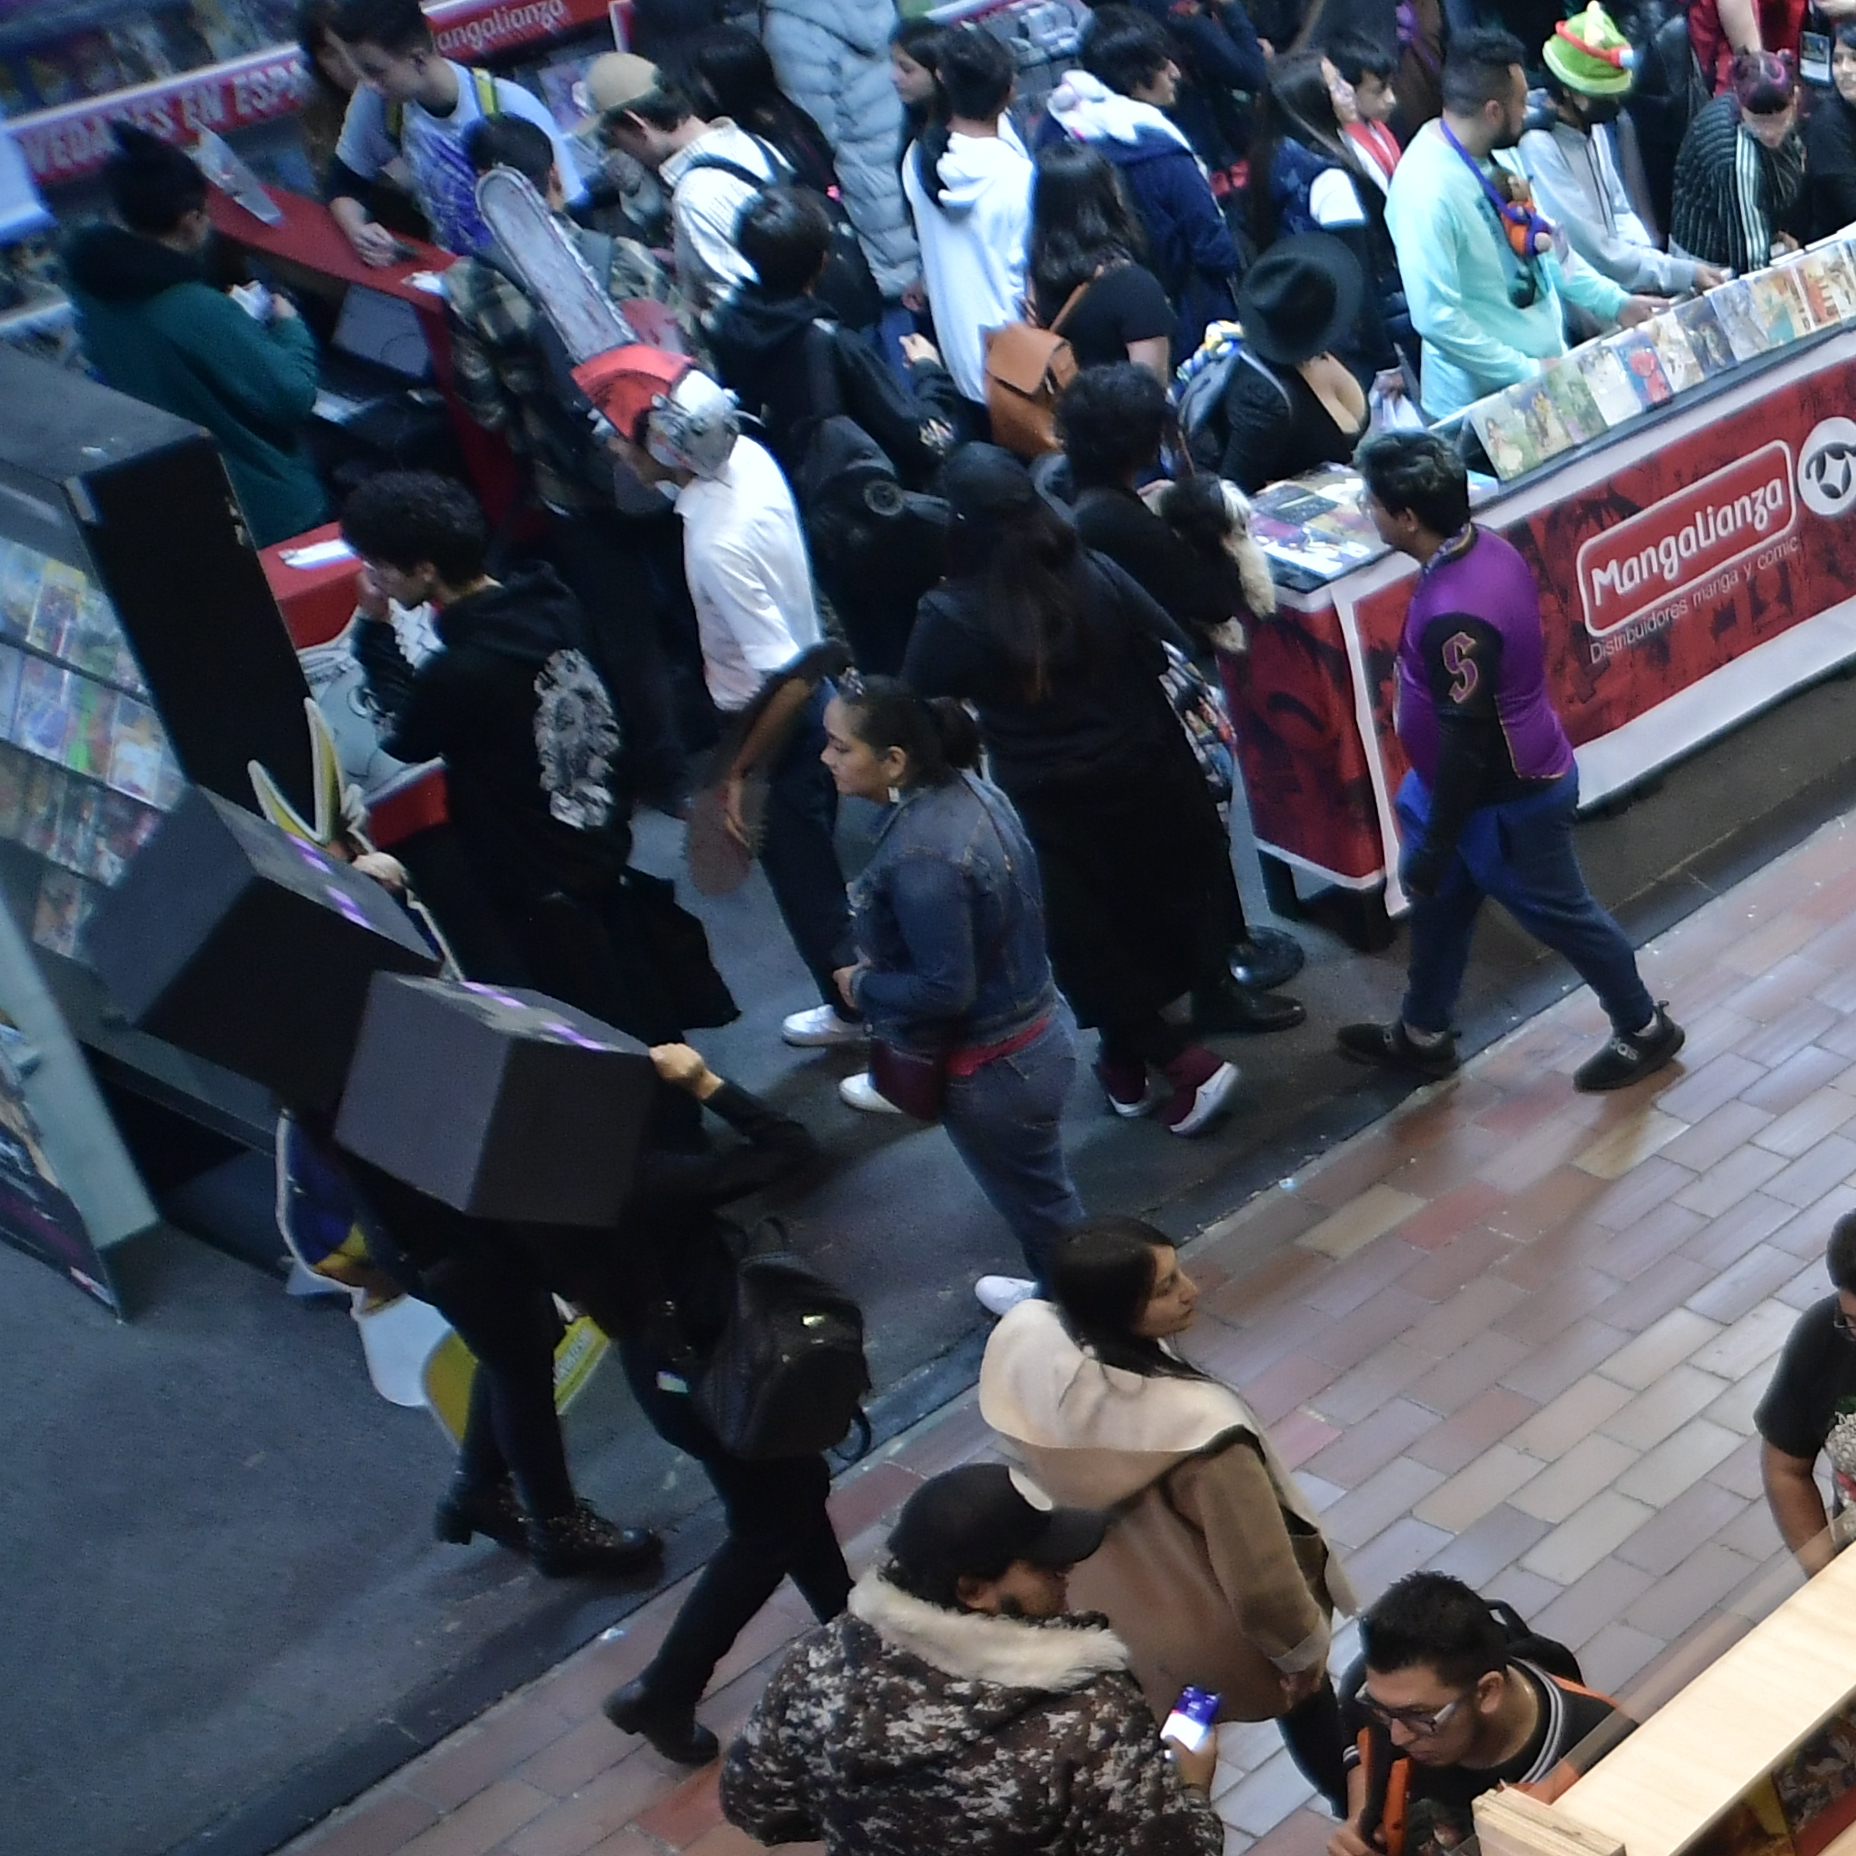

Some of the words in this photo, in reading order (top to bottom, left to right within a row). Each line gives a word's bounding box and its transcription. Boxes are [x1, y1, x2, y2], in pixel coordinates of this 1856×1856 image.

[436, 0, 566, 52] angalianza
[1590, 598, 1689, 664] Distribuidores
[1693, 568, 1739, 607] manga
[1757, 536, 1799, 571] comic
[1591, 479, 1783, 606] Mangalianza
